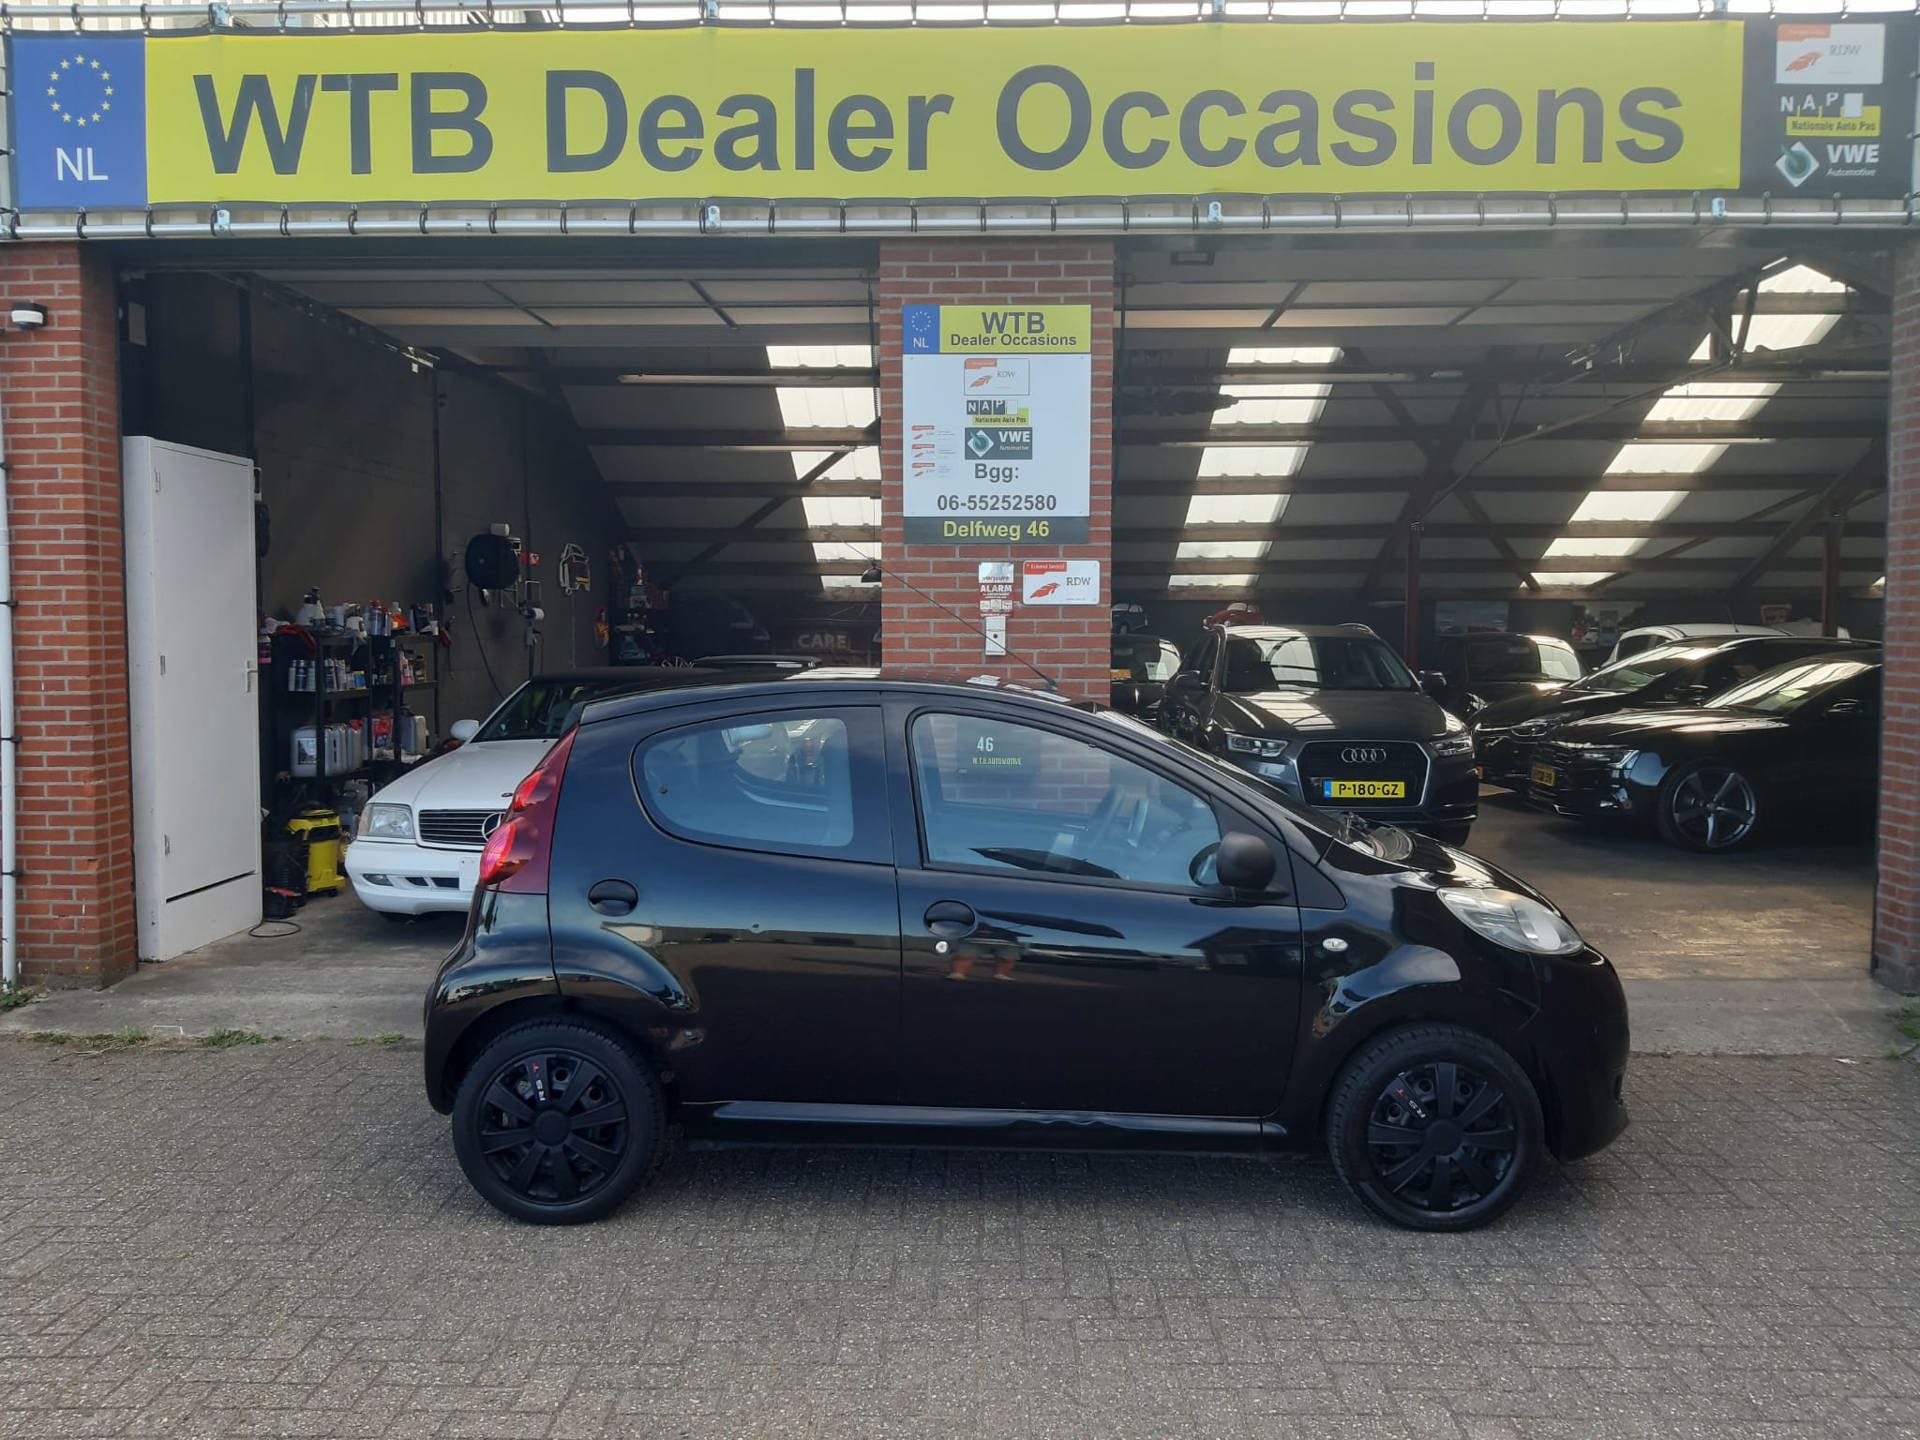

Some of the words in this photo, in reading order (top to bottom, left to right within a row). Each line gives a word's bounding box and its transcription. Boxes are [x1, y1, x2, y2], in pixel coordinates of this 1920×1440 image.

[193, 71, 495, 175] WTB
[546, 68, 955, 172] Dealer
[996, 62, 1685, 171] Occasions
[1826, 144, 1880, 163] VWE
[57, 148, 109, 181] NL
[981, 311, 1046, 334] WTB
[912, 337, 929, 348] NL
[951, 334, 996, 346] Dealer
[1000, 334, 1077, 346] Occasions
[998, 431, 1031, 442] VWE
[974, 463, 1019, 483] Bgg:
[937, 495, 1057, 511] 06-55252580
[943, 520, 1021, 541] Delfweg
[1026, 520, 1050, 537] 46
[980, 584, 1013, 593] ALARM
[1066, 576, 1091, 586] RDW
[798, 633, 848, 648] CARE
[976, 736, 995, 752] 46
[1338, 783, 1399, 796] P-180-GZ
